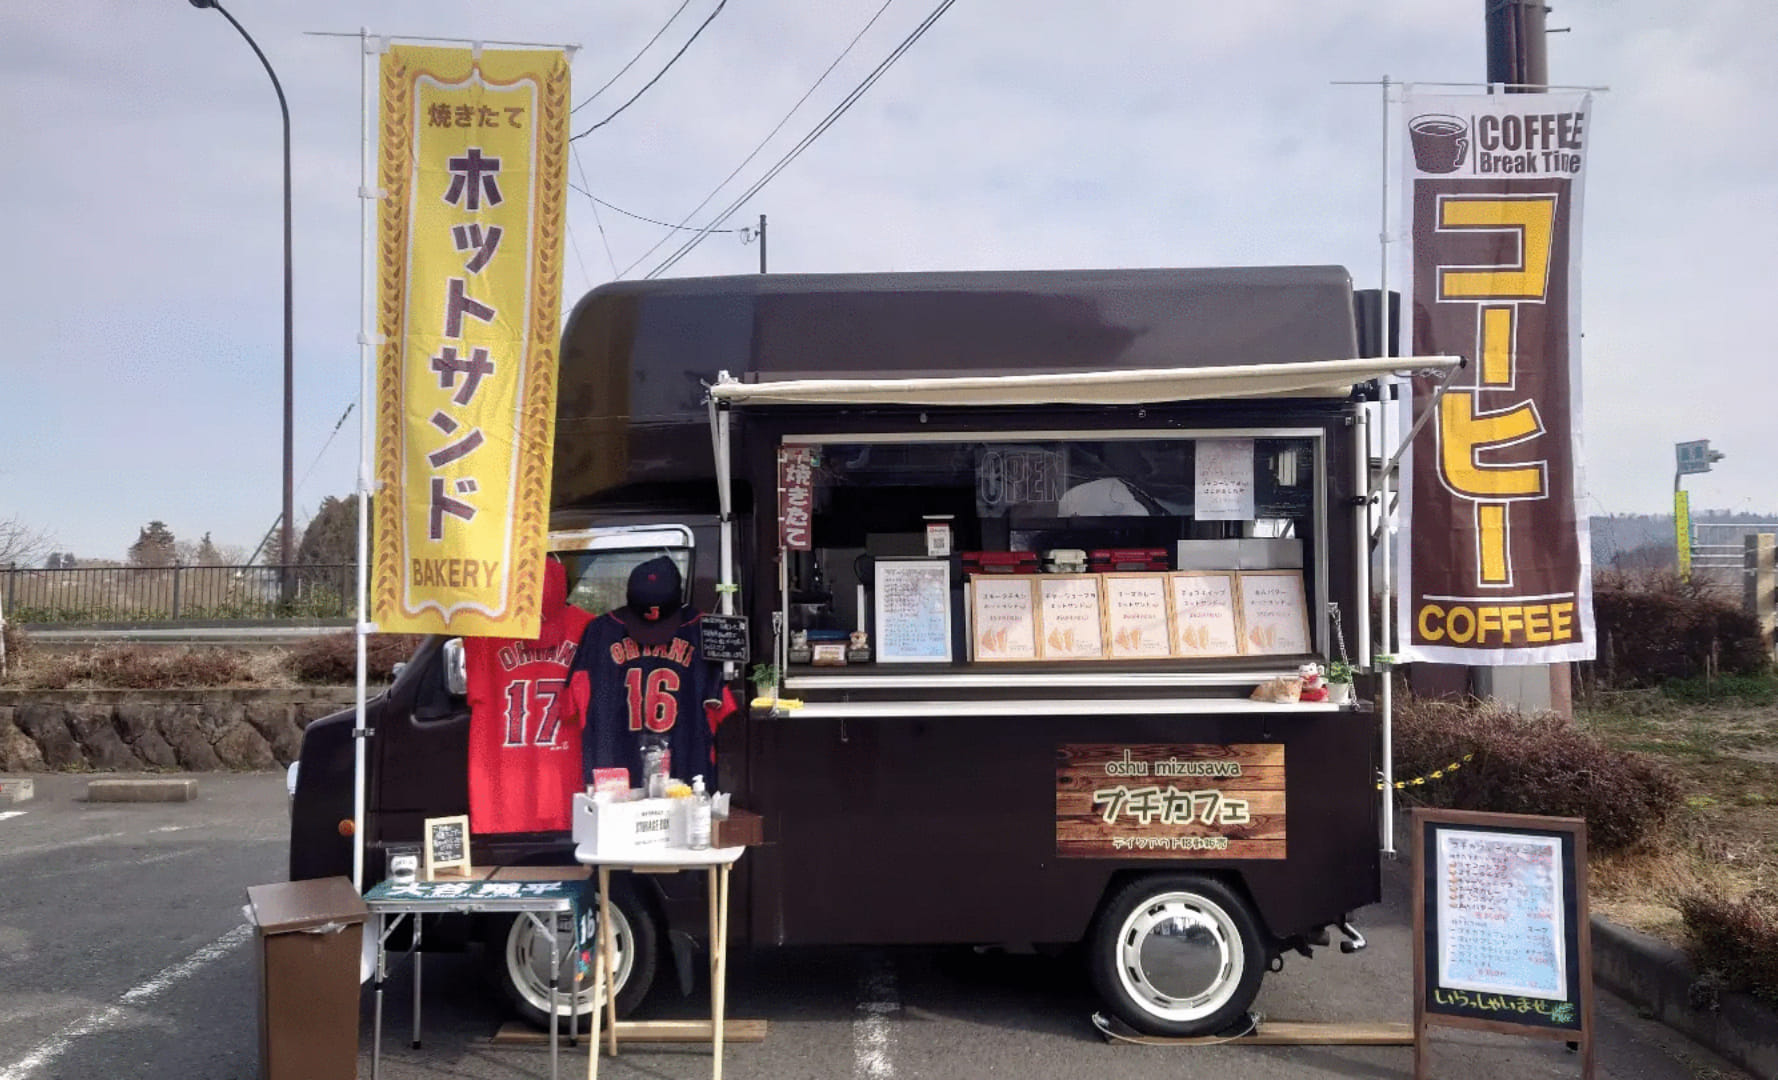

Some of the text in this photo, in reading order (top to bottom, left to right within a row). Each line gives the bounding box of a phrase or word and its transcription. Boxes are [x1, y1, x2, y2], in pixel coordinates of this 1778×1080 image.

[428, 102, 525, 129] 焼きたて
[1479, 112, 1584, 151] COFFEE
[1480, 151, 1538, 173] Break
[428, 148, 503, 541] ホットサンド
[1434, 192, 1558, 588] コーヒー
[412, 557, 498, 588] BAKERY
[1418, 602, 1574, 644] COFFEE
[498, 639, 578, 671] OHTAN
[503, 678, 570, 747] 17
[625, 667, 680, 733] 16
[1105, 749, 1241, 776] oshu mizusawa
[1093, 785, 1250, 825] プチカフェ
[581, 906, 596, 945] 16
[1434, 989, 1552, 1015] いらっしゃいませ
